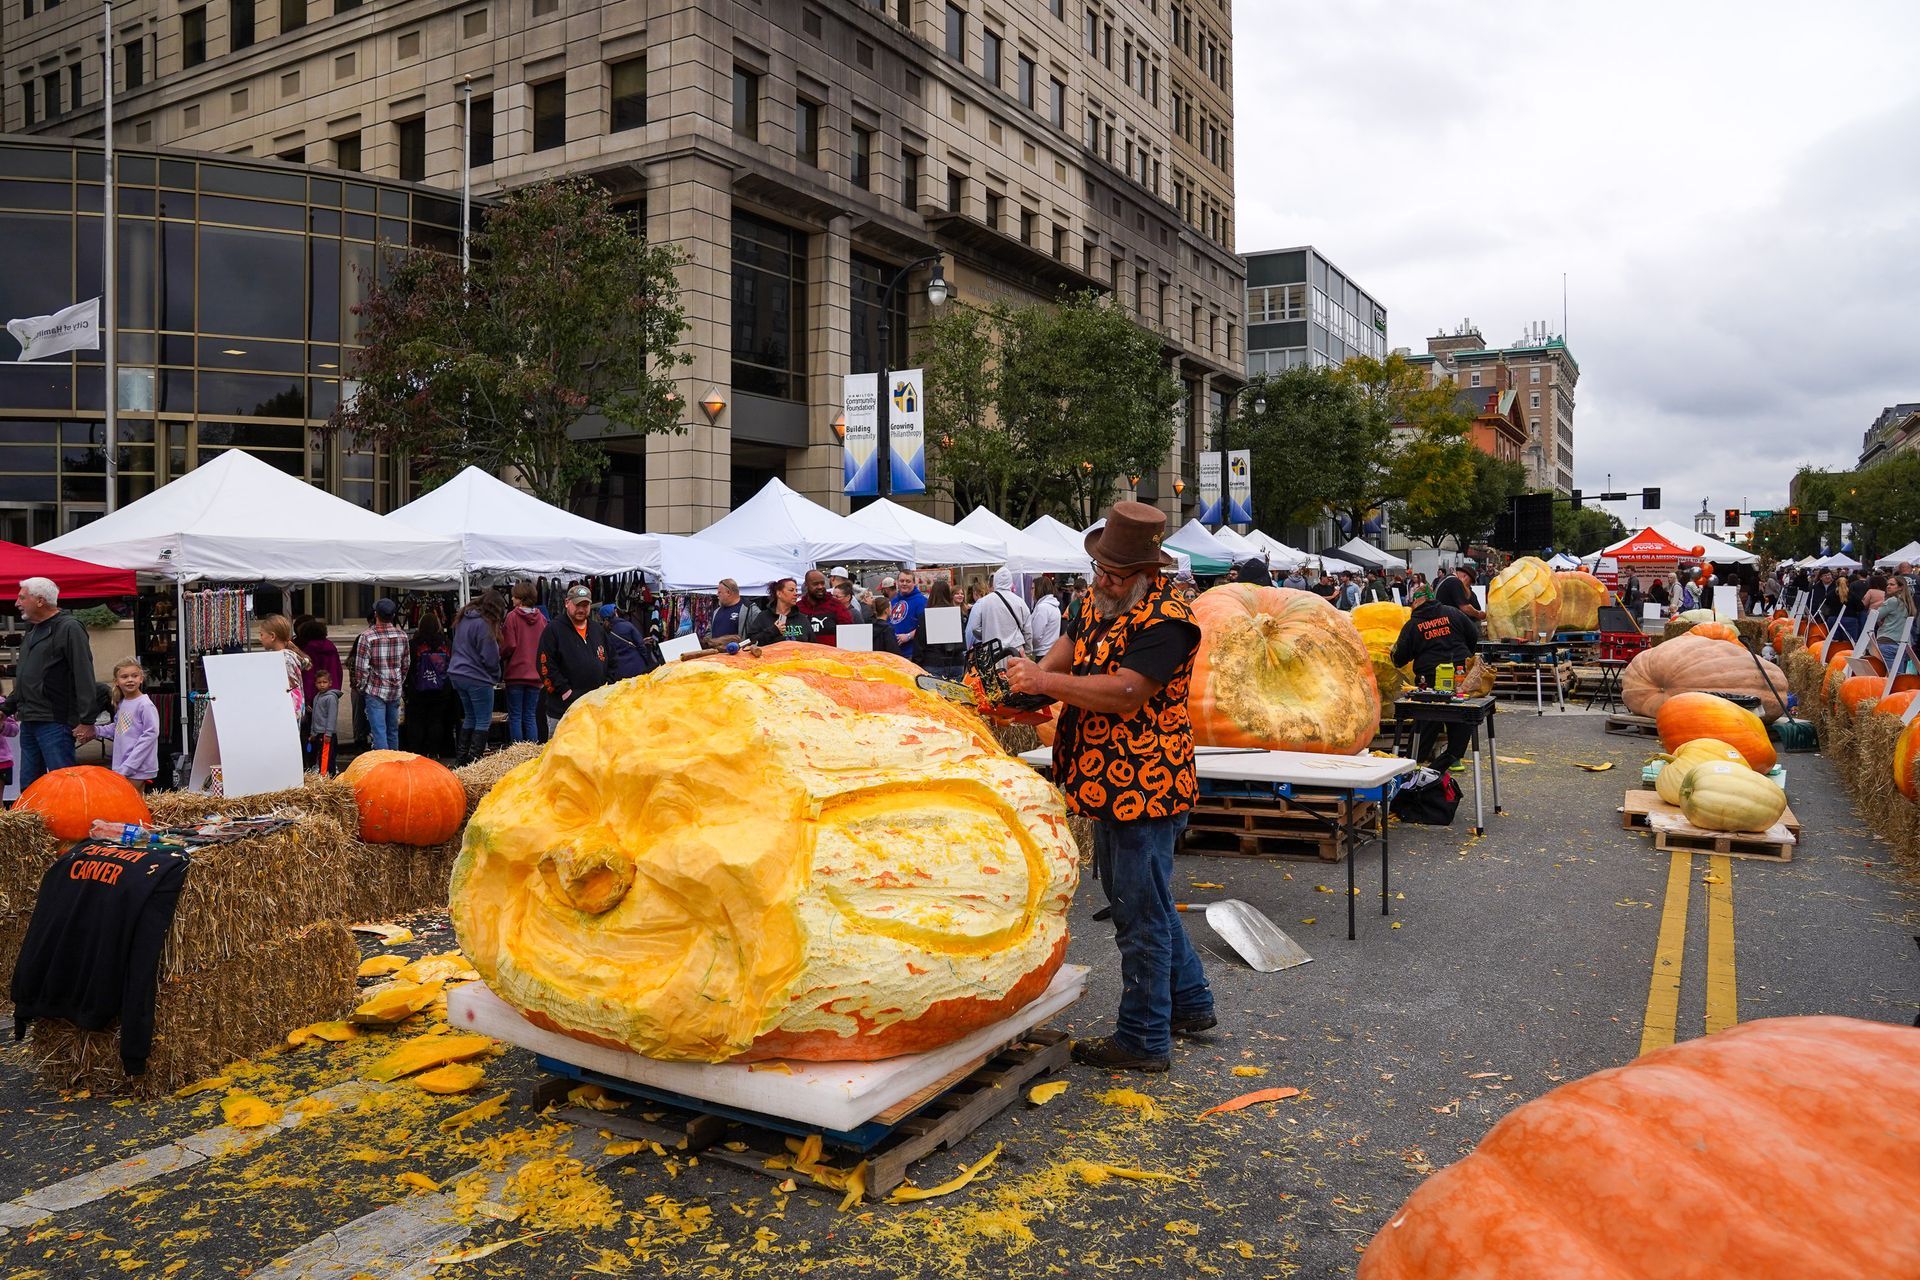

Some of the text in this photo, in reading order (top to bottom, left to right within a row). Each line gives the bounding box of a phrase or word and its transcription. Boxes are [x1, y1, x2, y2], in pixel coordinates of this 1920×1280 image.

[846, 397, 876, 406] Community
[846, 404, 876, 412] Foundation
[846, 425, 871, 433] Building
[890, 422, 914, 430] Growing
[846, 433, 876, 441] Community
[890, 430, 922, 438] Philanthropy
[1417, 616, 1450, 632] PUMPKIN
[1424, 626, 1451, 640] CARVER
[81, 844, 149, 863] PUMPKIN
[70, 860, 124, 886] CARVER
